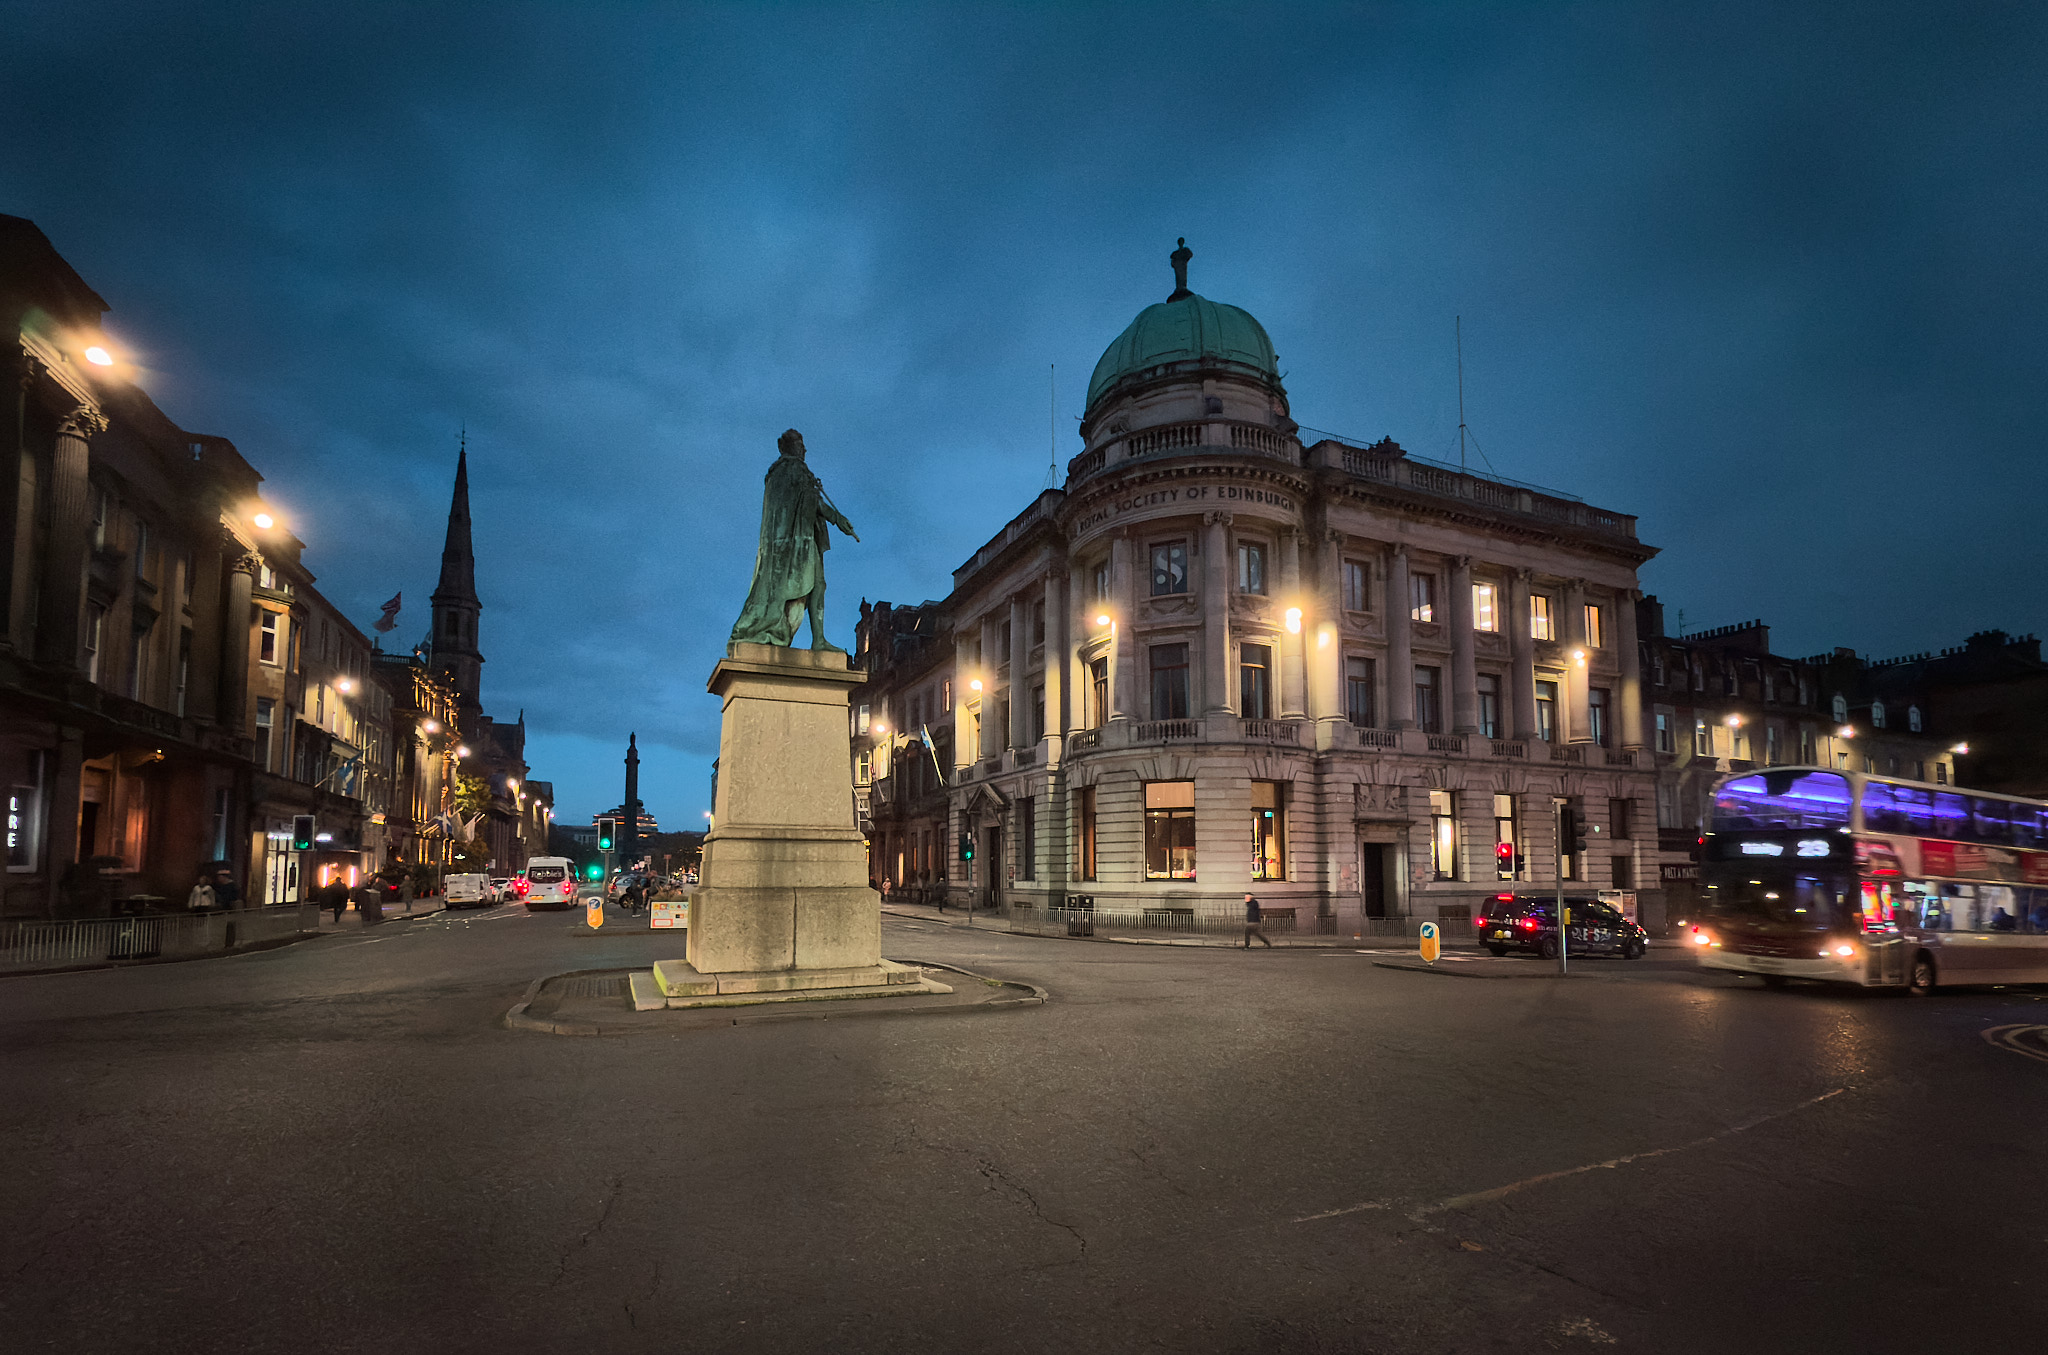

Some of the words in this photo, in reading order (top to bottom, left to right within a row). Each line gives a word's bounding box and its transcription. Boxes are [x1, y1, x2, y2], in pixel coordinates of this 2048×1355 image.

[1079, 507, 1109, 533] ROYAL
[1115, 489, 1179, 515] SOCIETY
[1187, 486, 1208, 499] OF
[1218, 486, 1295, 512] EDINBURGH
[1797, 840, 1830, 857] 23
